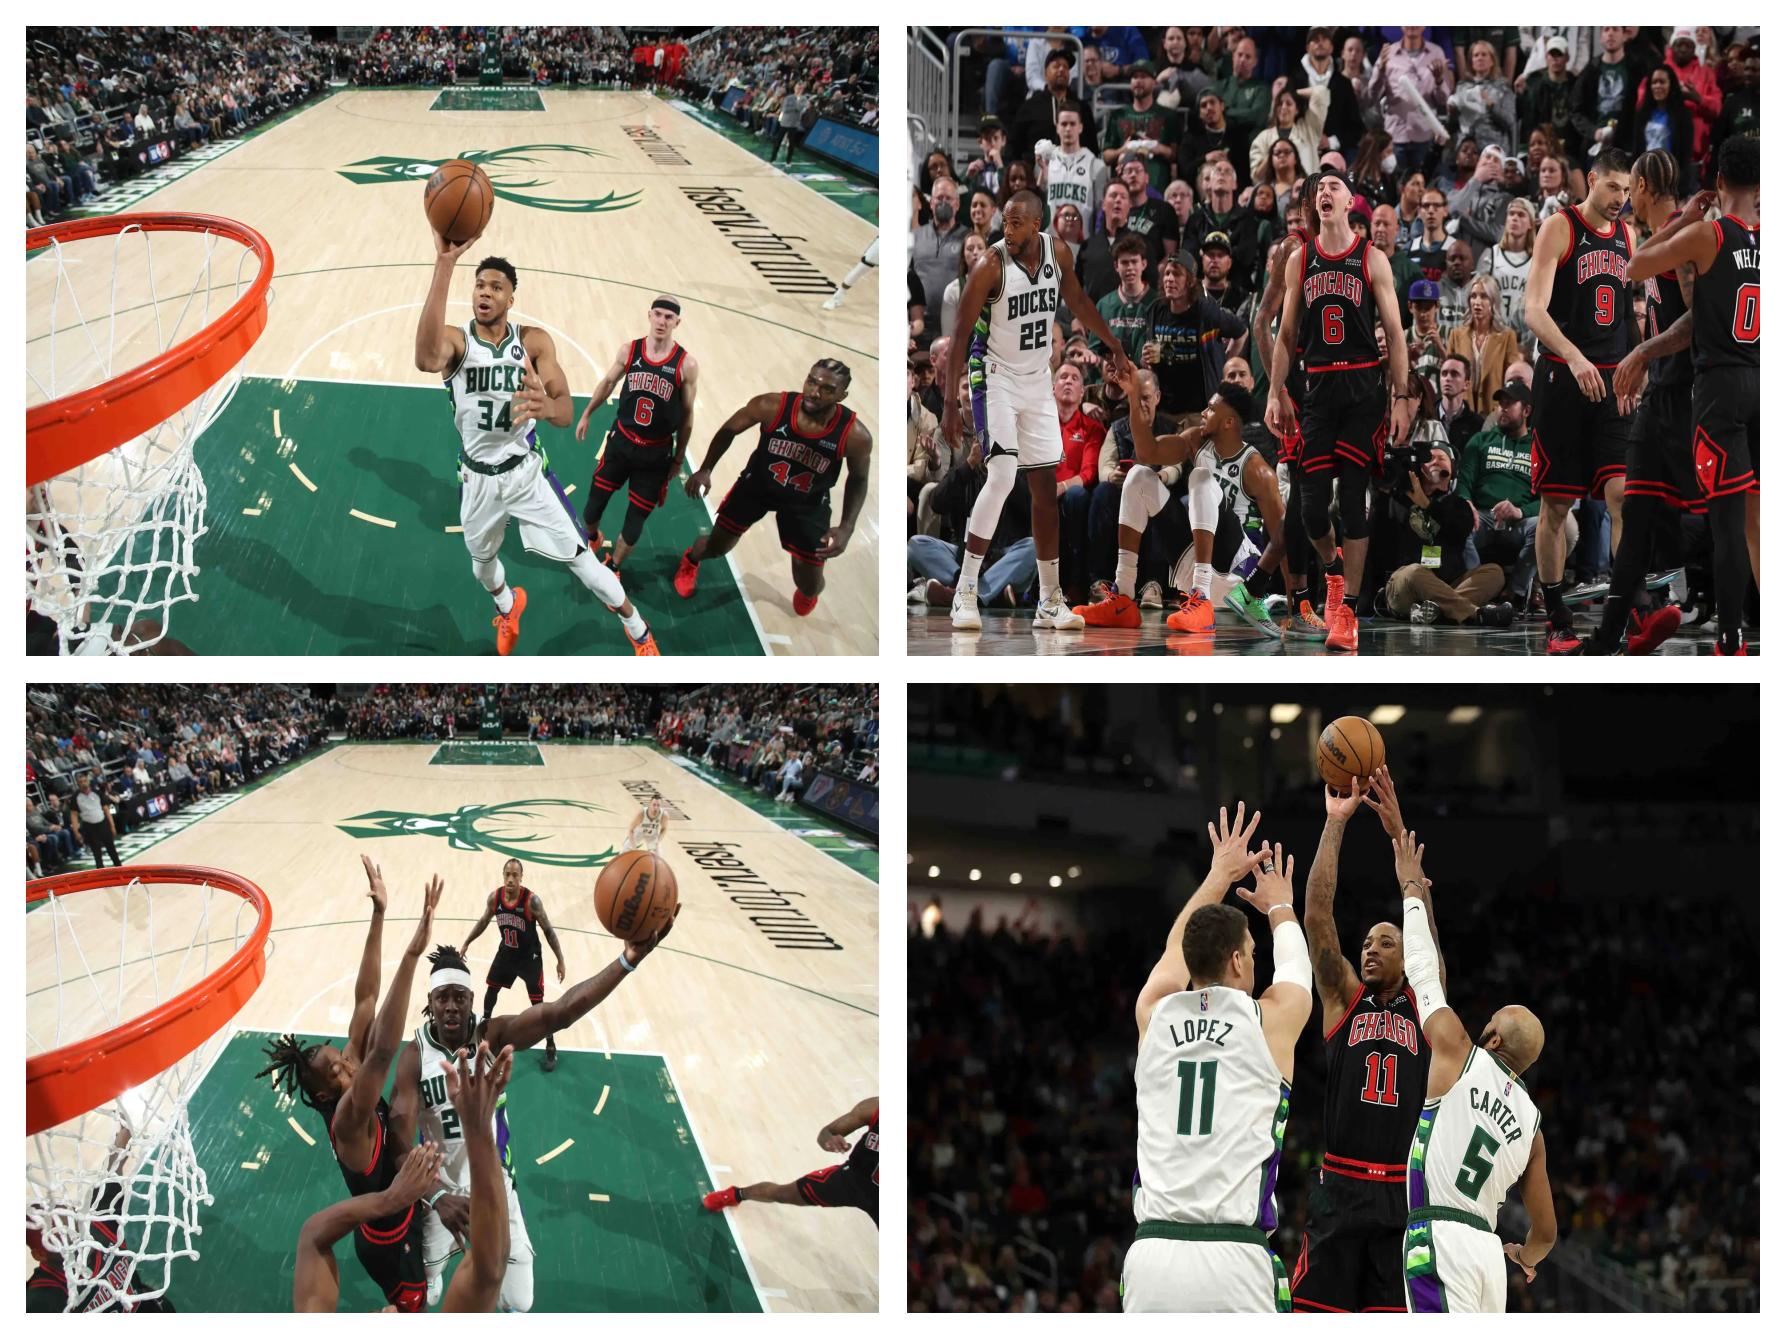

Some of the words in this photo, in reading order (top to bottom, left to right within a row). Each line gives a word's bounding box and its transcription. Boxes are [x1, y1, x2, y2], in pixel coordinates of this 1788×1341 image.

[1050, 183, 1087, 203] BUCKS
[679, 186, 839, 295] fiserv.forum
[1008, 288, 1056, 321] BUCKS
[1303, 270, 1363, 309] CHICAGO
[1595, 285, 1616, 326] 9
[1321, 305, 1345, 345] 6
[1732, 282, 1760, 344] 0
[1020, 319, 1047, 351] 22
[465, 364, 527, 394] BUCKS
[627, 371, 674, 402] CHICAGO
[477, 400, 512, 432] 34
[634, 396, 655, 426] 6
[767, 437, 831, 474] CHICAGO
[768, 460, 815, 494] 44
[617, 872, 651, 932] Wilson
[678, 841, 844, 950] fiserv.forum
[496, 913, 526, 932] CHICAGO
[503, 928, 519, 949] 11
[1169, 1018, 1234, 1048] LOPEZ
[1361, 1051, 1399, 1108] 11
[1177, 1060, 1218, 1136] 11
[441, 1108, 462, 1140] 2
[1470, 1087, 1523, 1145] CARTER
[1454, 1124, 1501, 1202] 5
